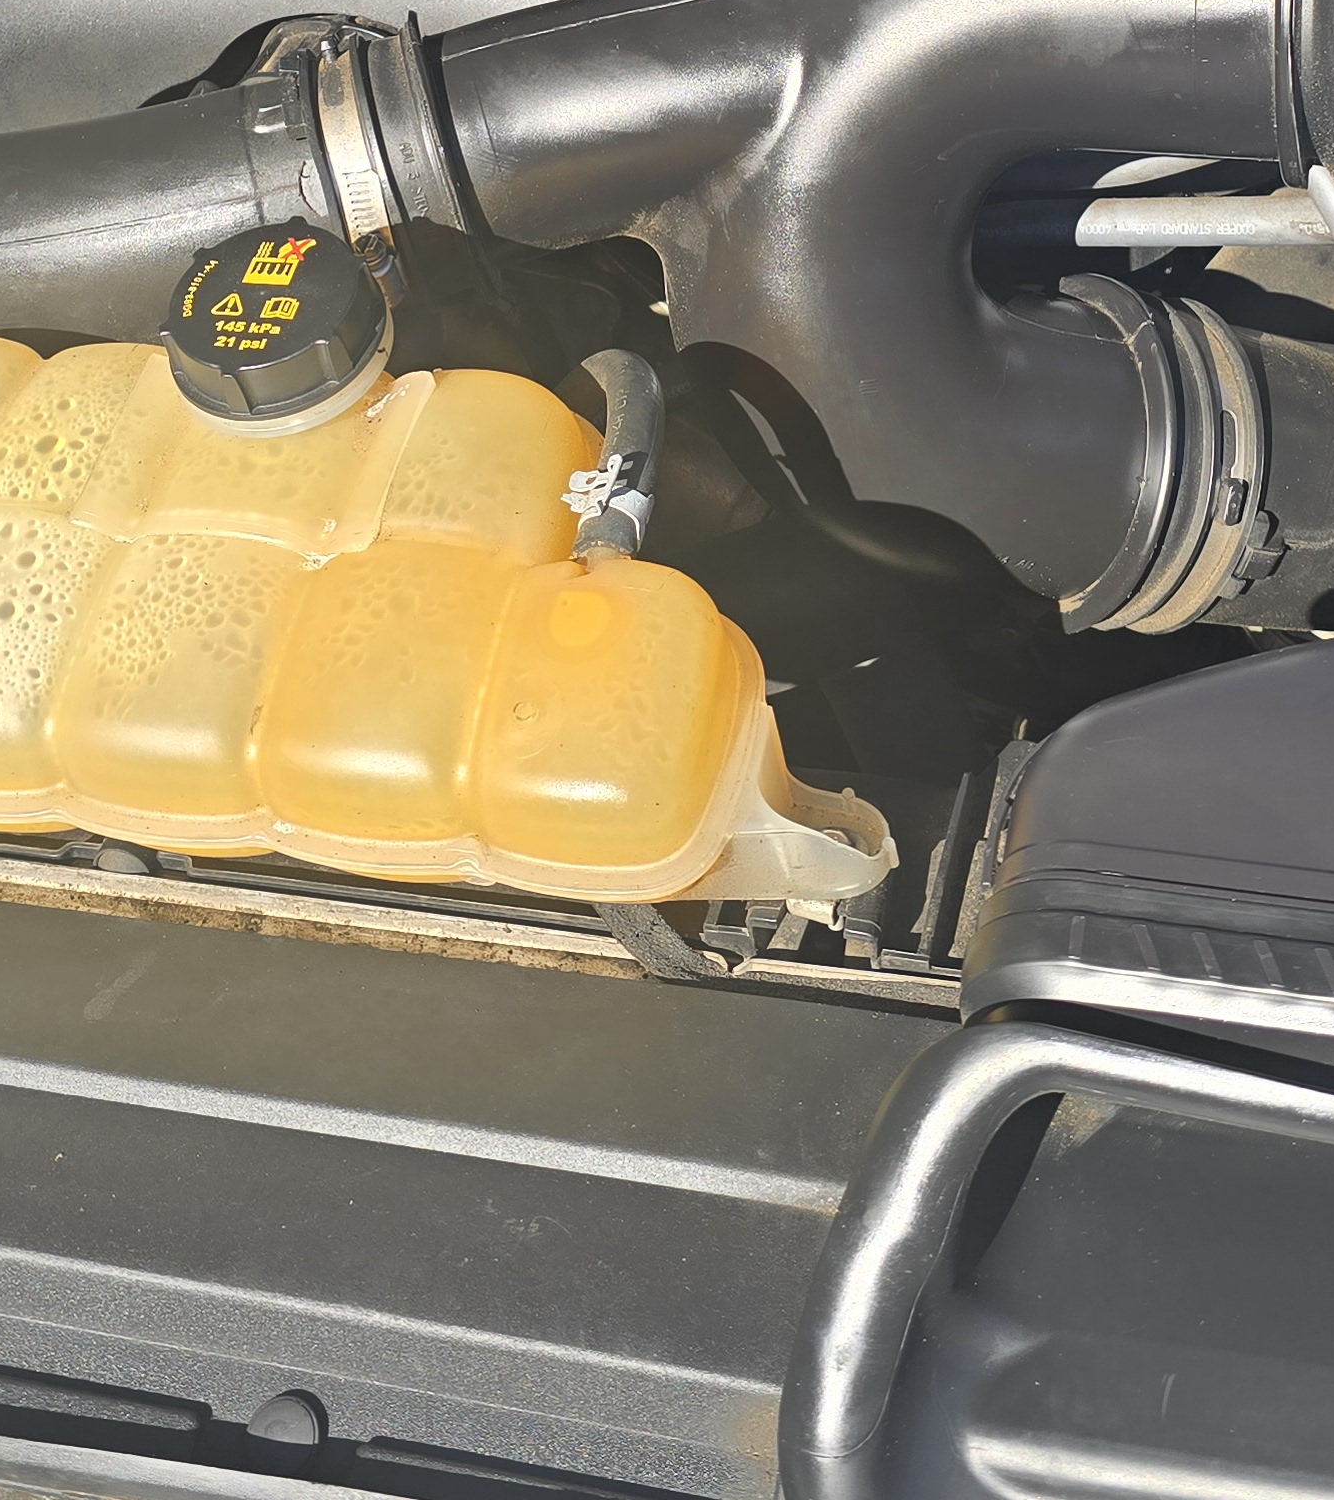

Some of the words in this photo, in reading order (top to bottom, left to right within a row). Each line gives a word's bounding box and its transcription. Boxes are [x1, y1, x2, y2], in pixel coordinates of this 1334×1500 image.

[1160, 223, 1213, 236] STANDARD
[1216, 223, 1256, 235] COOPER
[214, 319, 246, 332] 145
[248, 321, 281, 335] kPa
[213, 335, 237, 348] 21
[238, 338, 268, 351] psi
